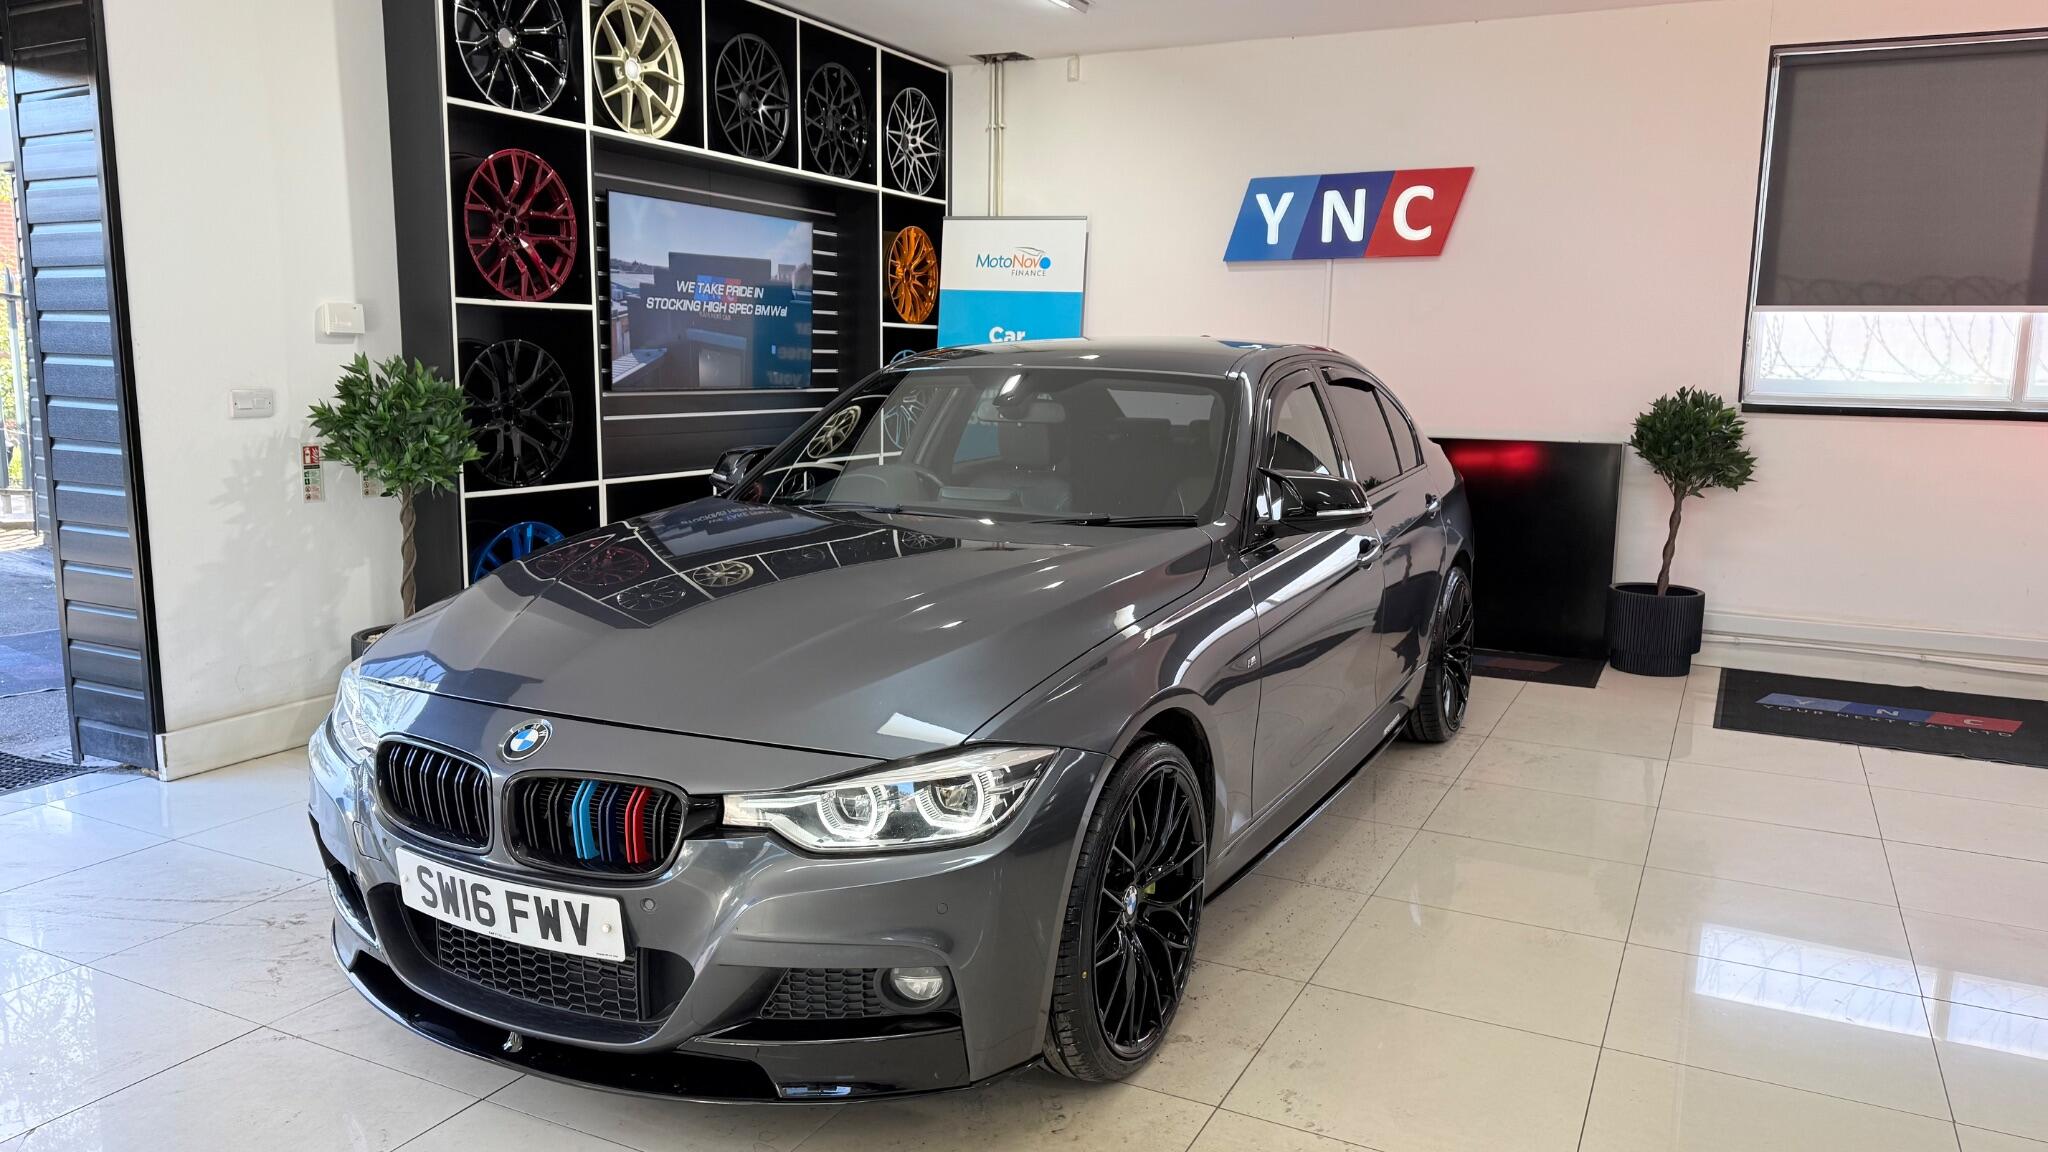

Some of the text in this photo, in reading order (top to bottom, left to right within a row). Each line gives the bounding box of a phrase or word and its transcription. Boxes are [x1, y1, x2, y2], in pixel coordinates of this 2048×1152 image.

[1255, 185, 1435, 245] YNC
[975, 253, 1052, 270] MotoNovo
[1011, 269, 1047, 277] FINANCE
[676, 280, 764, 299] WE TAKE PRIDE IN
[646, 296, 701, 312] STOCKING
[702, 300, 727, 313] HIGH
[728, 302, 753, 315] SPEC
[988, 326, 1026, 343] Car
[1763, 704, 2012, 738] YOUR NEXT CAR LTD
[416, 864, 590, 947] SW16 FWV
